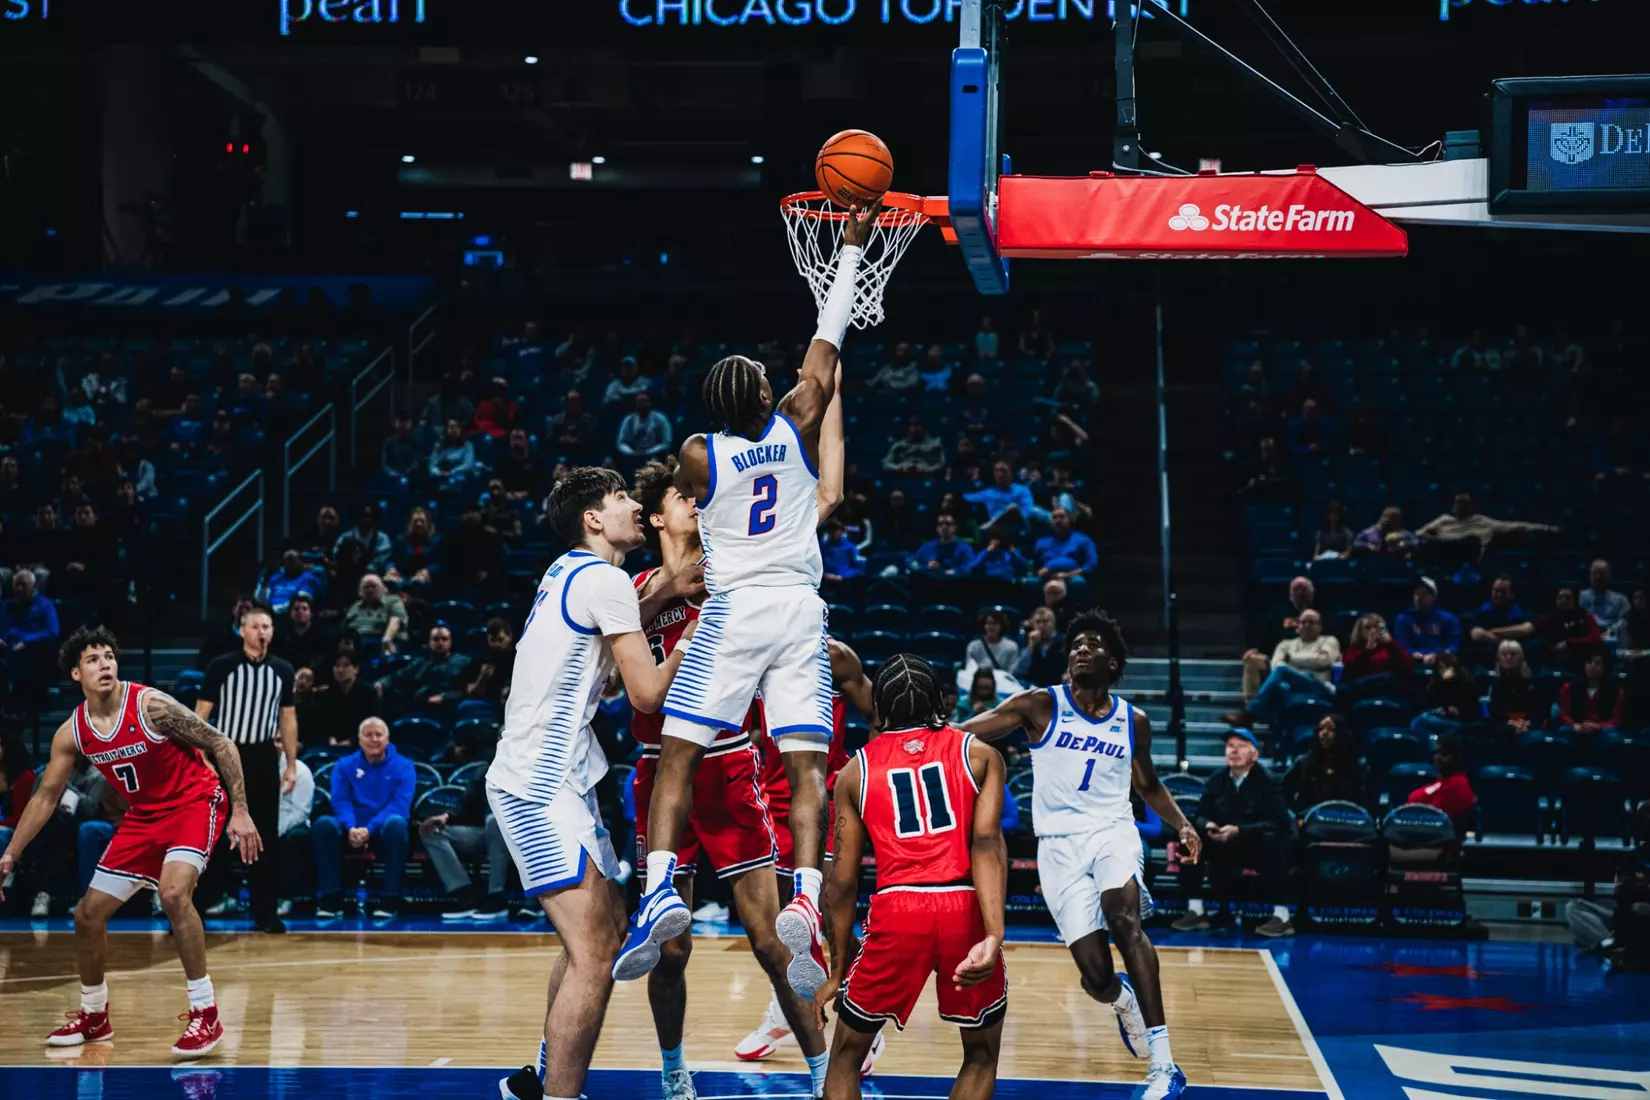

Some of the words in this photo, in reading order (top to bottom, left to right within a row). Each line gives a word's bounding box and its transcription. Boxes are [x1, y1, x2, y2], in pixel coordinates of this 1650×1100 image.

[618, 0, 857, 26] CHICAGO
[731, 444, 787, 473] BLOCKER
[748, 473, 778, 536] 2
[117, 741, 148, 759] MERCY
[112, 762, 140, 793] 7
[1078, 758, 1096, 791] 1
[887, 761, 957, 839] 11
